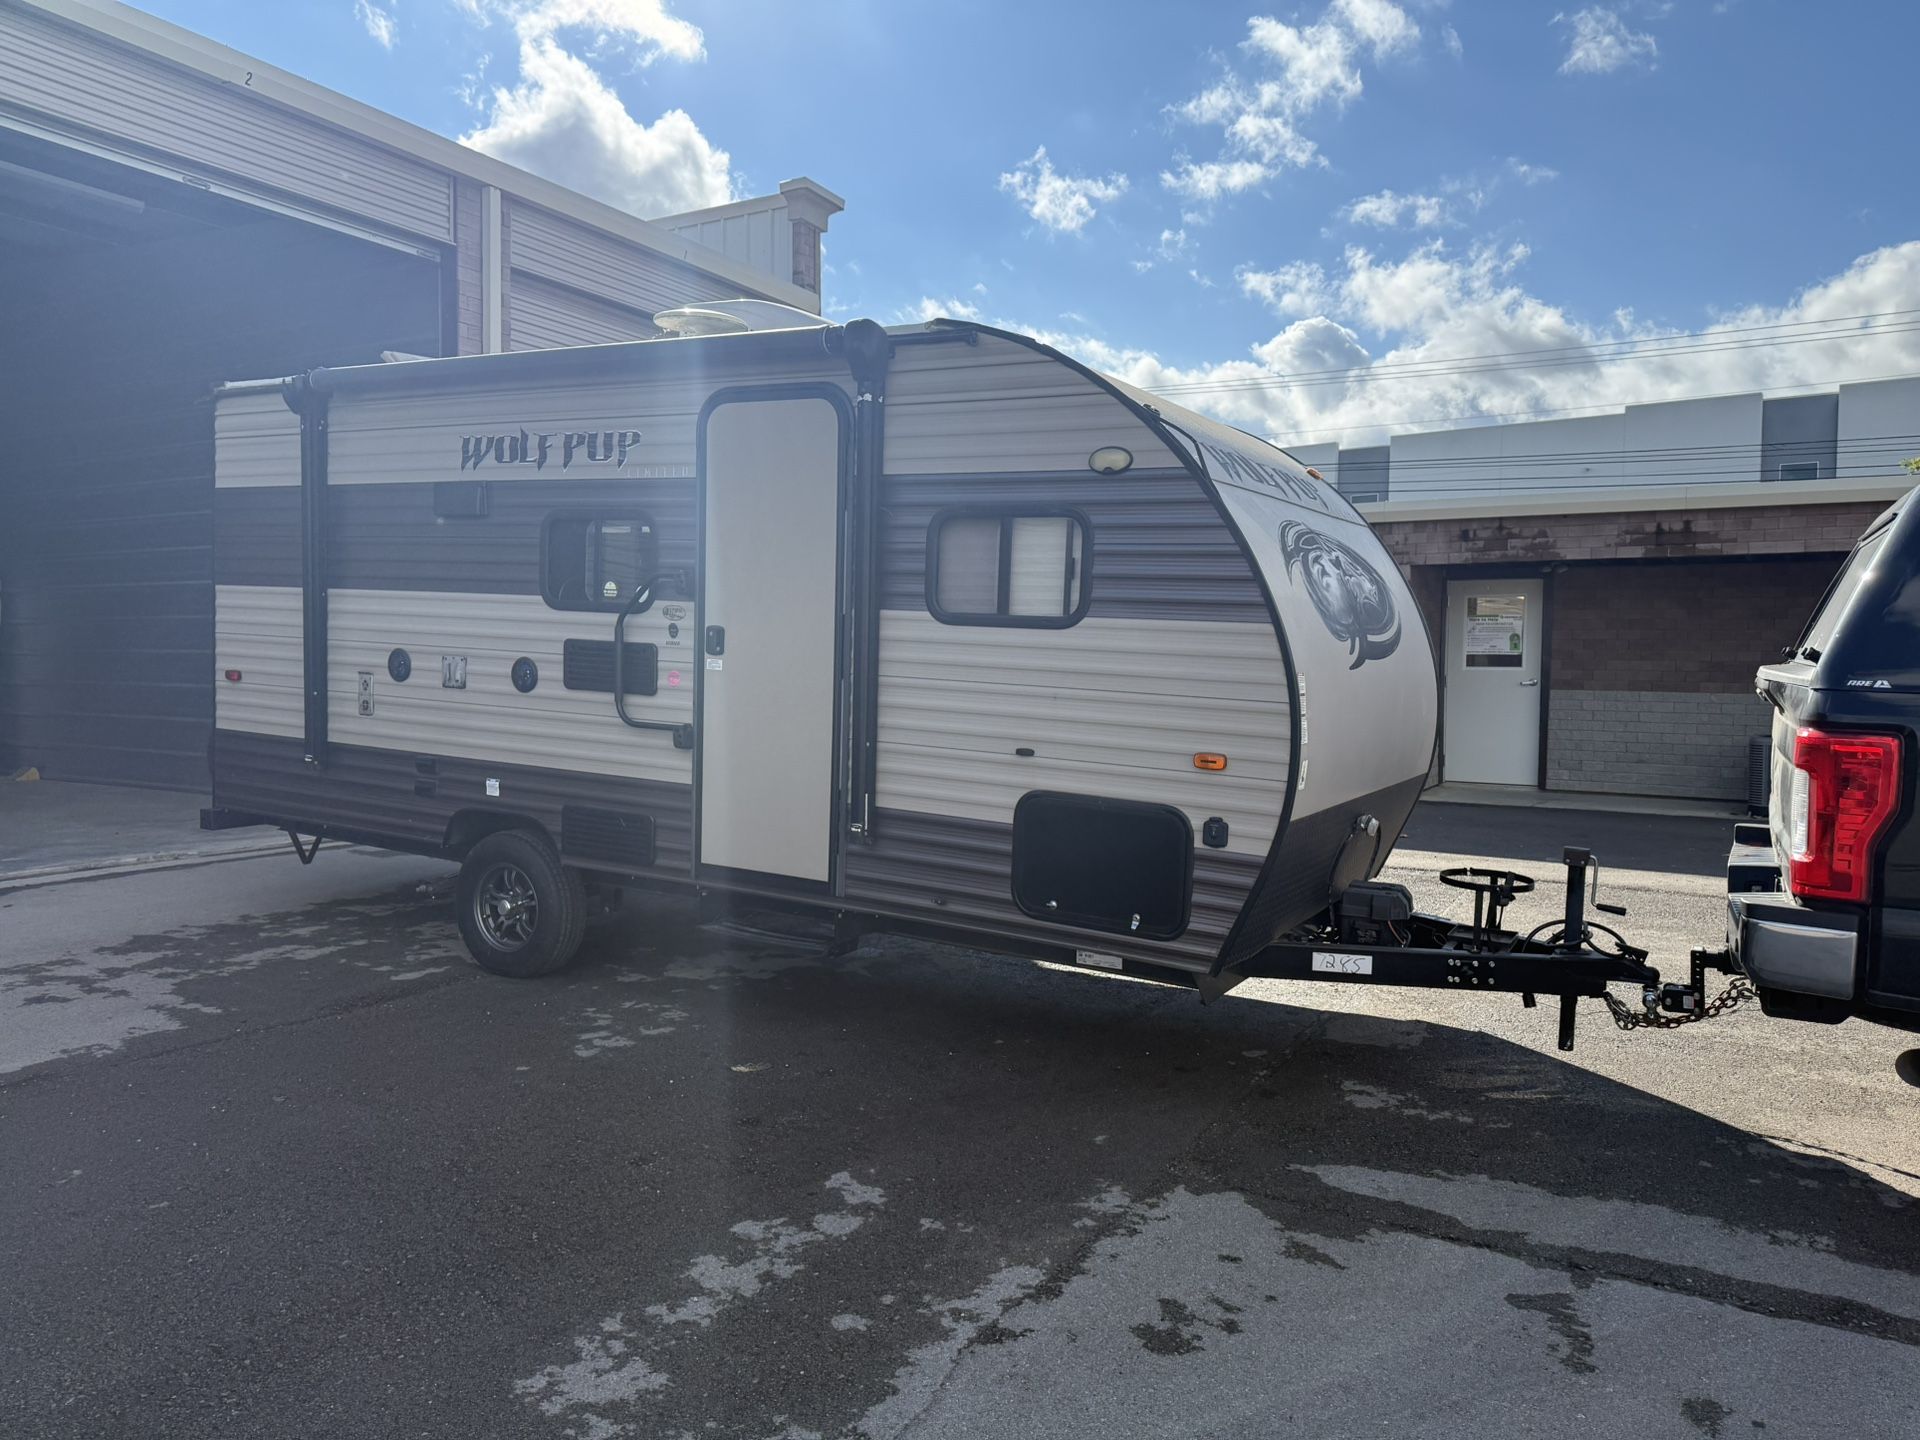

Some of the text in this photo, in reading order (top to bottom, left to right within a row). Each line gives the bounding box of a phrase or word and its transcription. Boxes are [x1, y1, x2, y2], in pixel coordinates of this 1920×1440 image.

[245, 71, 253, 86] 2
[459, 426, 642, 472] WOLF PUP
